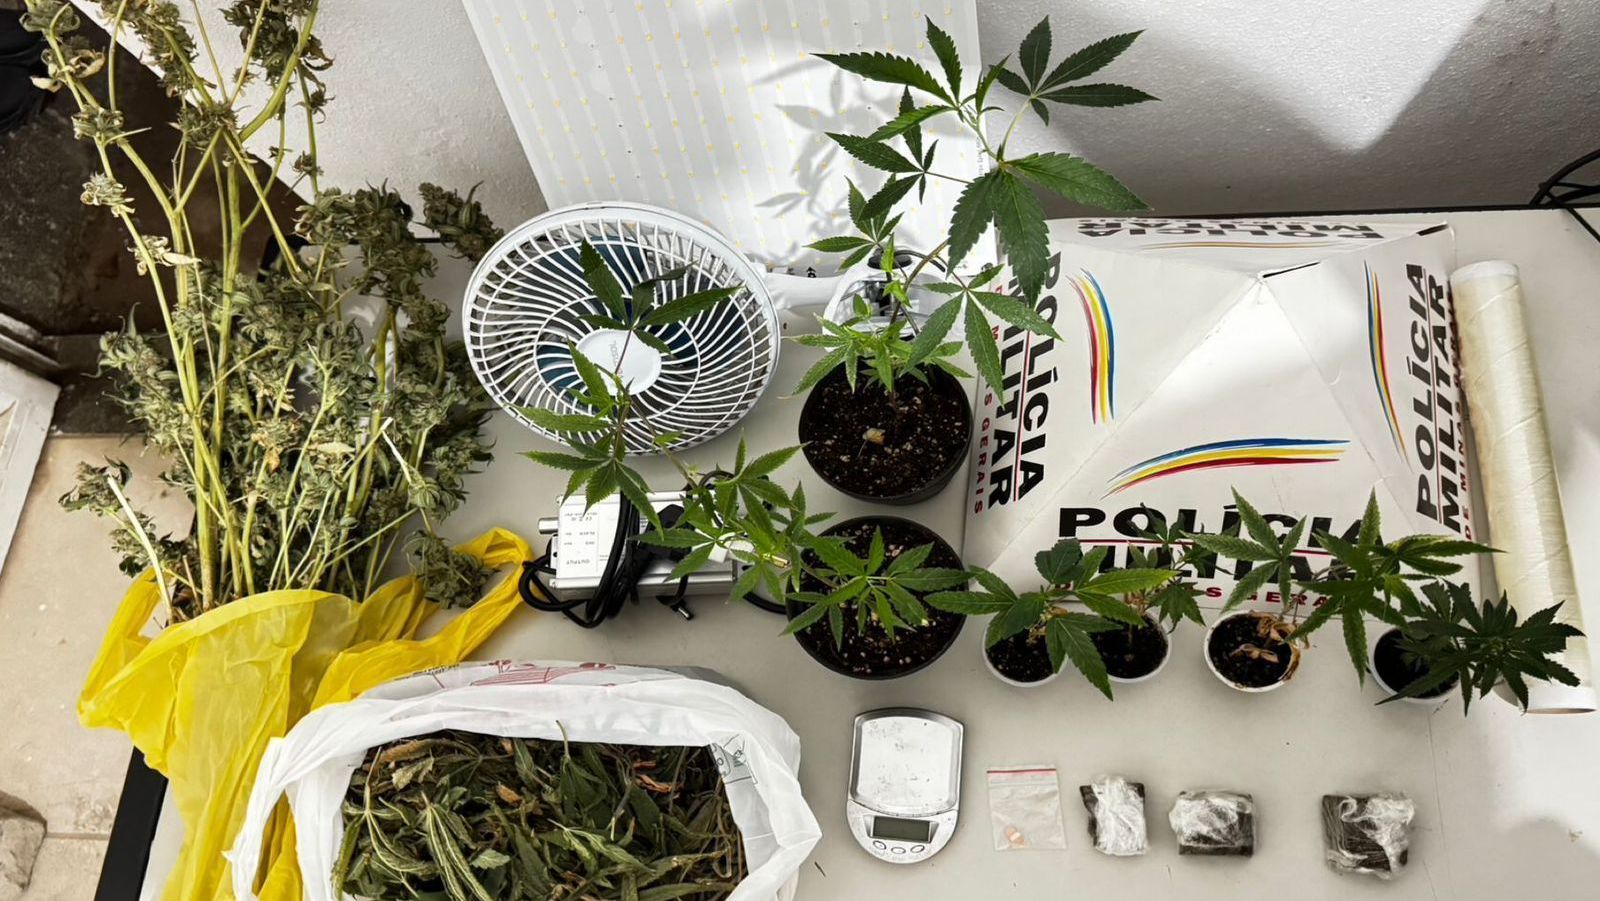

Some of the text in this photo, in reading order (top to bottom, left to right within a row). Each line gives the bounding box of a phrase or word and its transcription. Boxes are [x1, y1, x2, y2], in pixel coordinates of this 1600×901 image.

[1078, 222, 1374, 232] MILITAR
[1018, 251, 1061, 501] POLÍCIA
[1405, 264, 1438, 521] POLÍCIA
[1428, 274, 1461, 534] MILITAR
[974, 417, 991, 515] GERAIS
[1455, 401, 1467, 491] MINAS
[1462, 505, 1472, 540] DE
